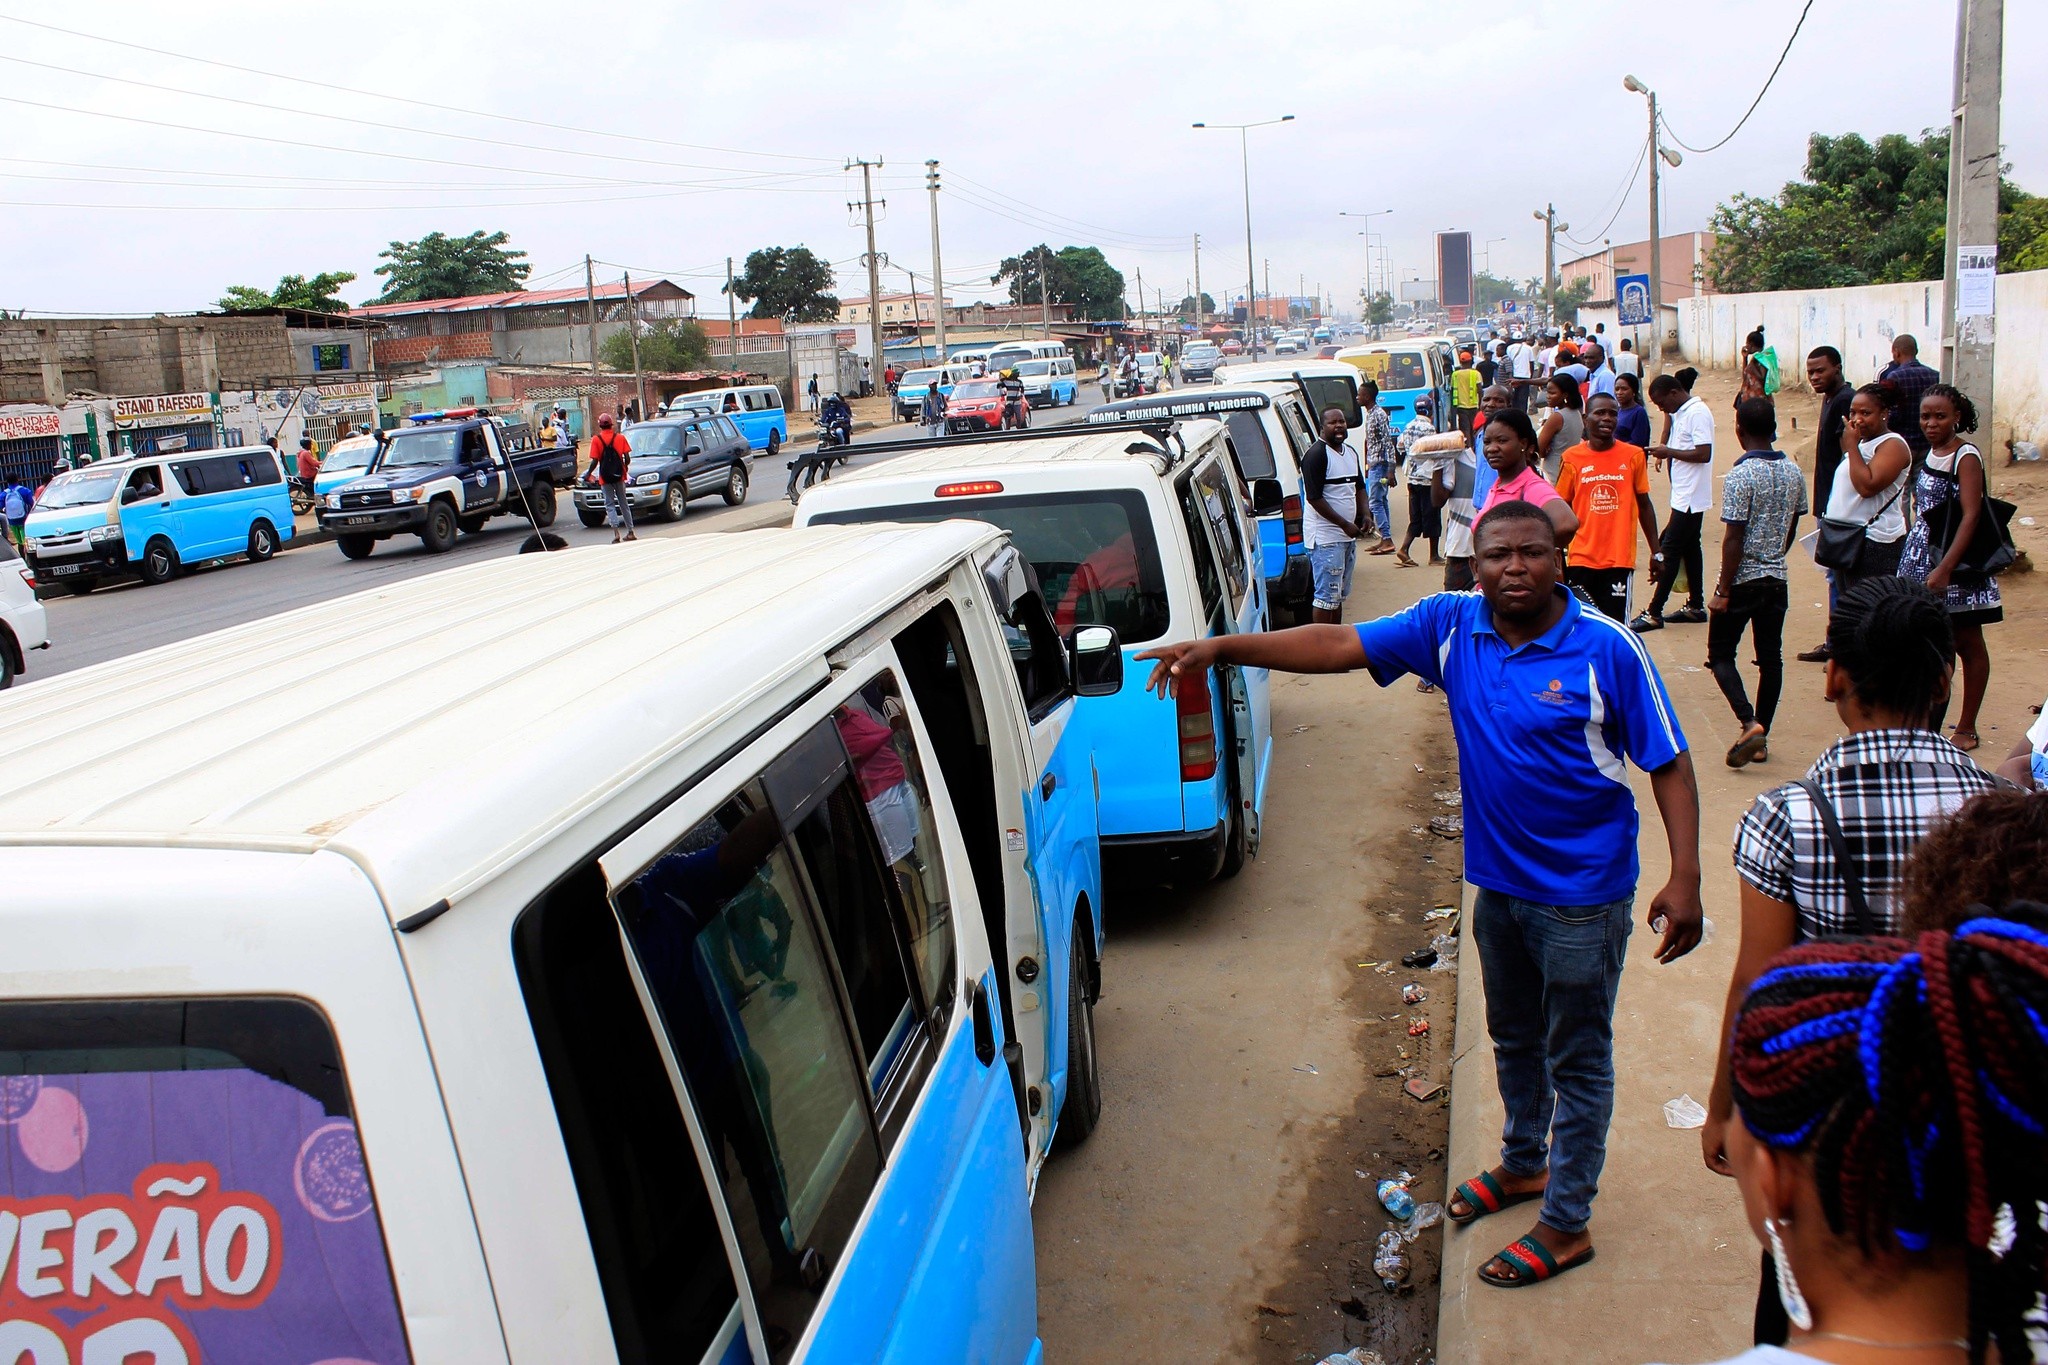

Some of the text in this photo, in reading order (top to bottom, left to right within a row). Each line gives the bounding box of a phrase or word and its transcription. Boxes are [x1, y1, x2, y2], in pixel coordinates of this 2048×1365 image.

[318, 385, 342, 397] STAND
[117, 394, 204, 415] STAND RAFESCO
[1171, 403, 1205, 416] MINHA
[1207, 396, 1263, 411] PADROEIRA
[1581, 474, 1625, 484] SportScheck
[1590, 503, 1619, 511] Chemnitz
